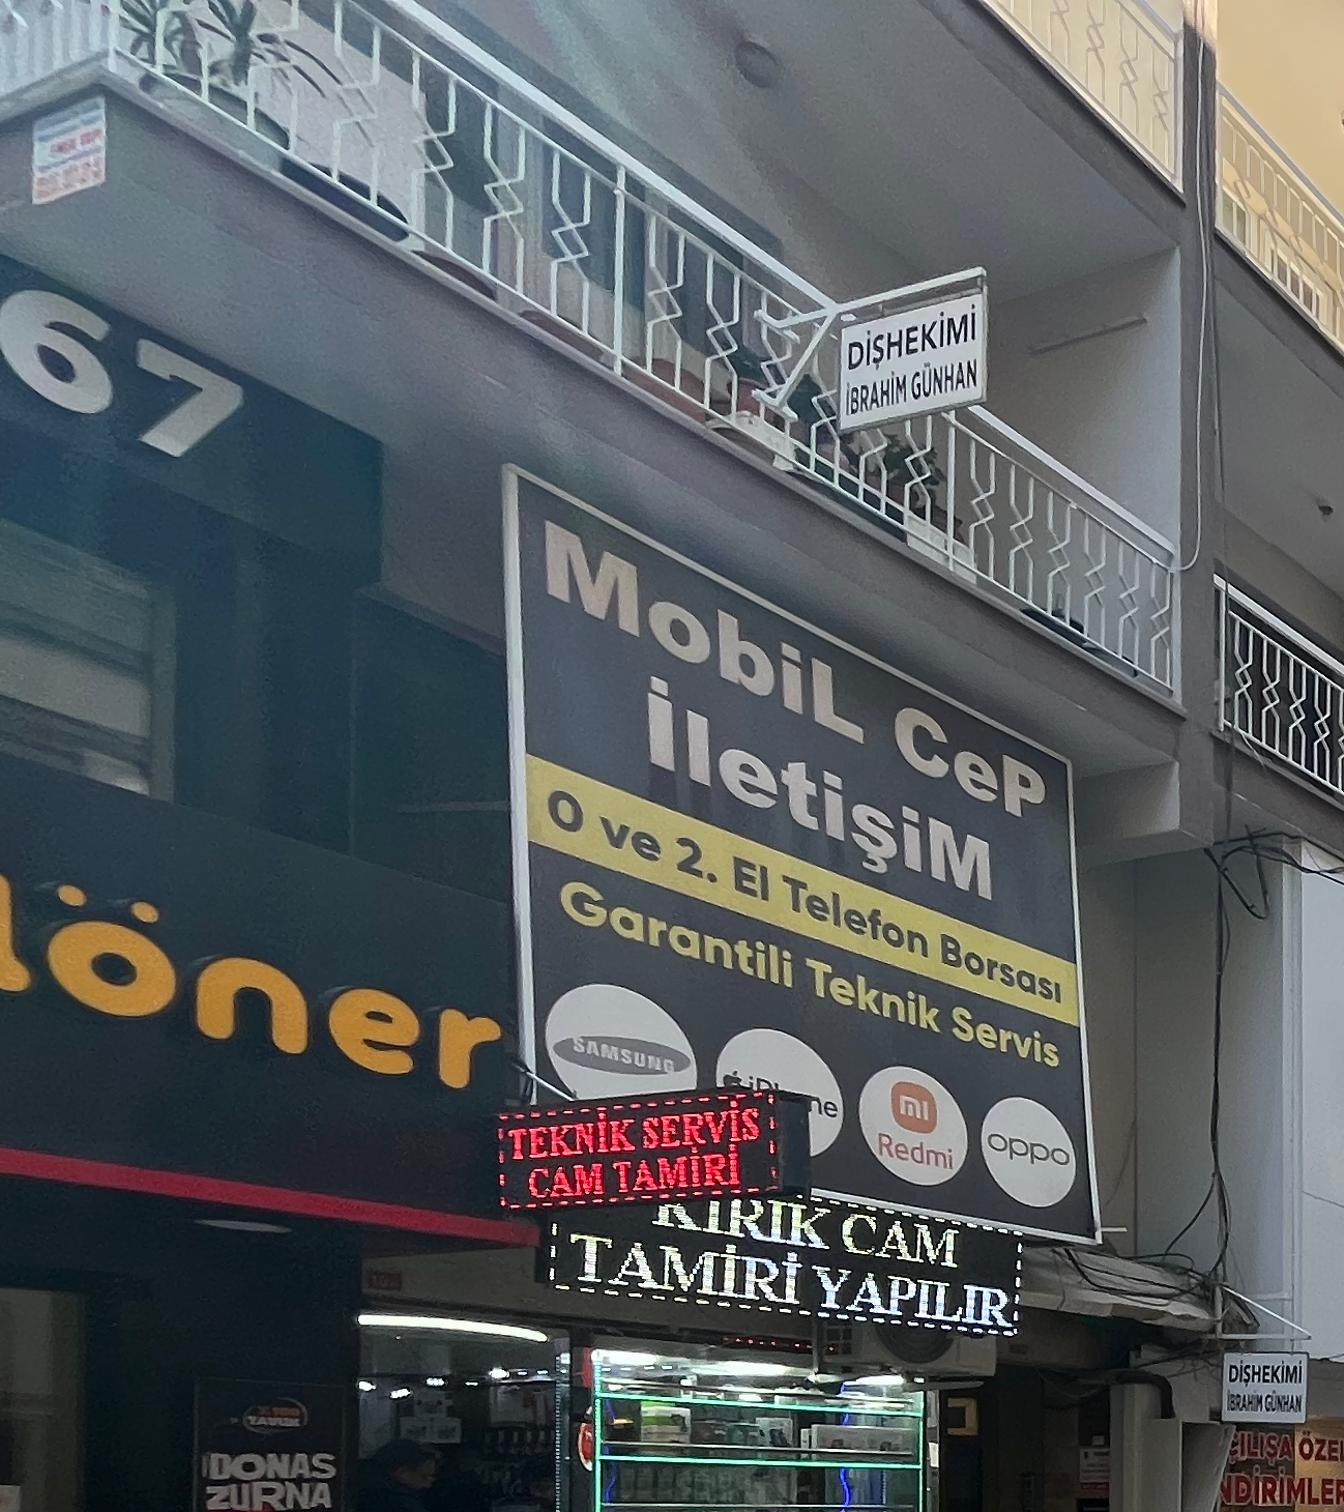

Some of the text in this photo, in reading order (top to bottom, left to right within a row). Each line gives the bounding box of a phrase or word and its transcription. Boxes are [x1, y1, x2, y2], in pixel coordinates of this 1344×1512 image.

[847, 304, 977, 371] DİŞHEKİMİ
[846, 359, 978, 416] İBRAHİM GÜNHAN
[544, 520, 1047, 818] MobiL CeP
[600, 814, 661, 862] ve
[676, 837, 718, 884] 2.
[734, 855, 770, 901] El
[782, 873, 928, 958] Telefon
[940, 932, 1063, 1003] Borsası
[560, 881, 1061, 1068] Garantili Teknik Servis
[573, 1036, 675, 1074] SAMSUNG
[507, 1099, 760, 1160] TEKNİK SERVİS
[878, 1132, 953, 1170] Redmi
[987, 1132, 1070, 1166] oppo
[528, 1143, 740, 1199] CAM TAMİRİ
[842, 1213, 959, 1268] CAM
[570, 1232, 1013, 1329] TAMİRİ YAPILIR
[1227, 1389, 1302, 1413] İBRAHİM GÜNHAN
[1228, 1360, 1302, 1387] DİŞHEKİMİ
[205, 1481, 332, 1512] ZURNA
